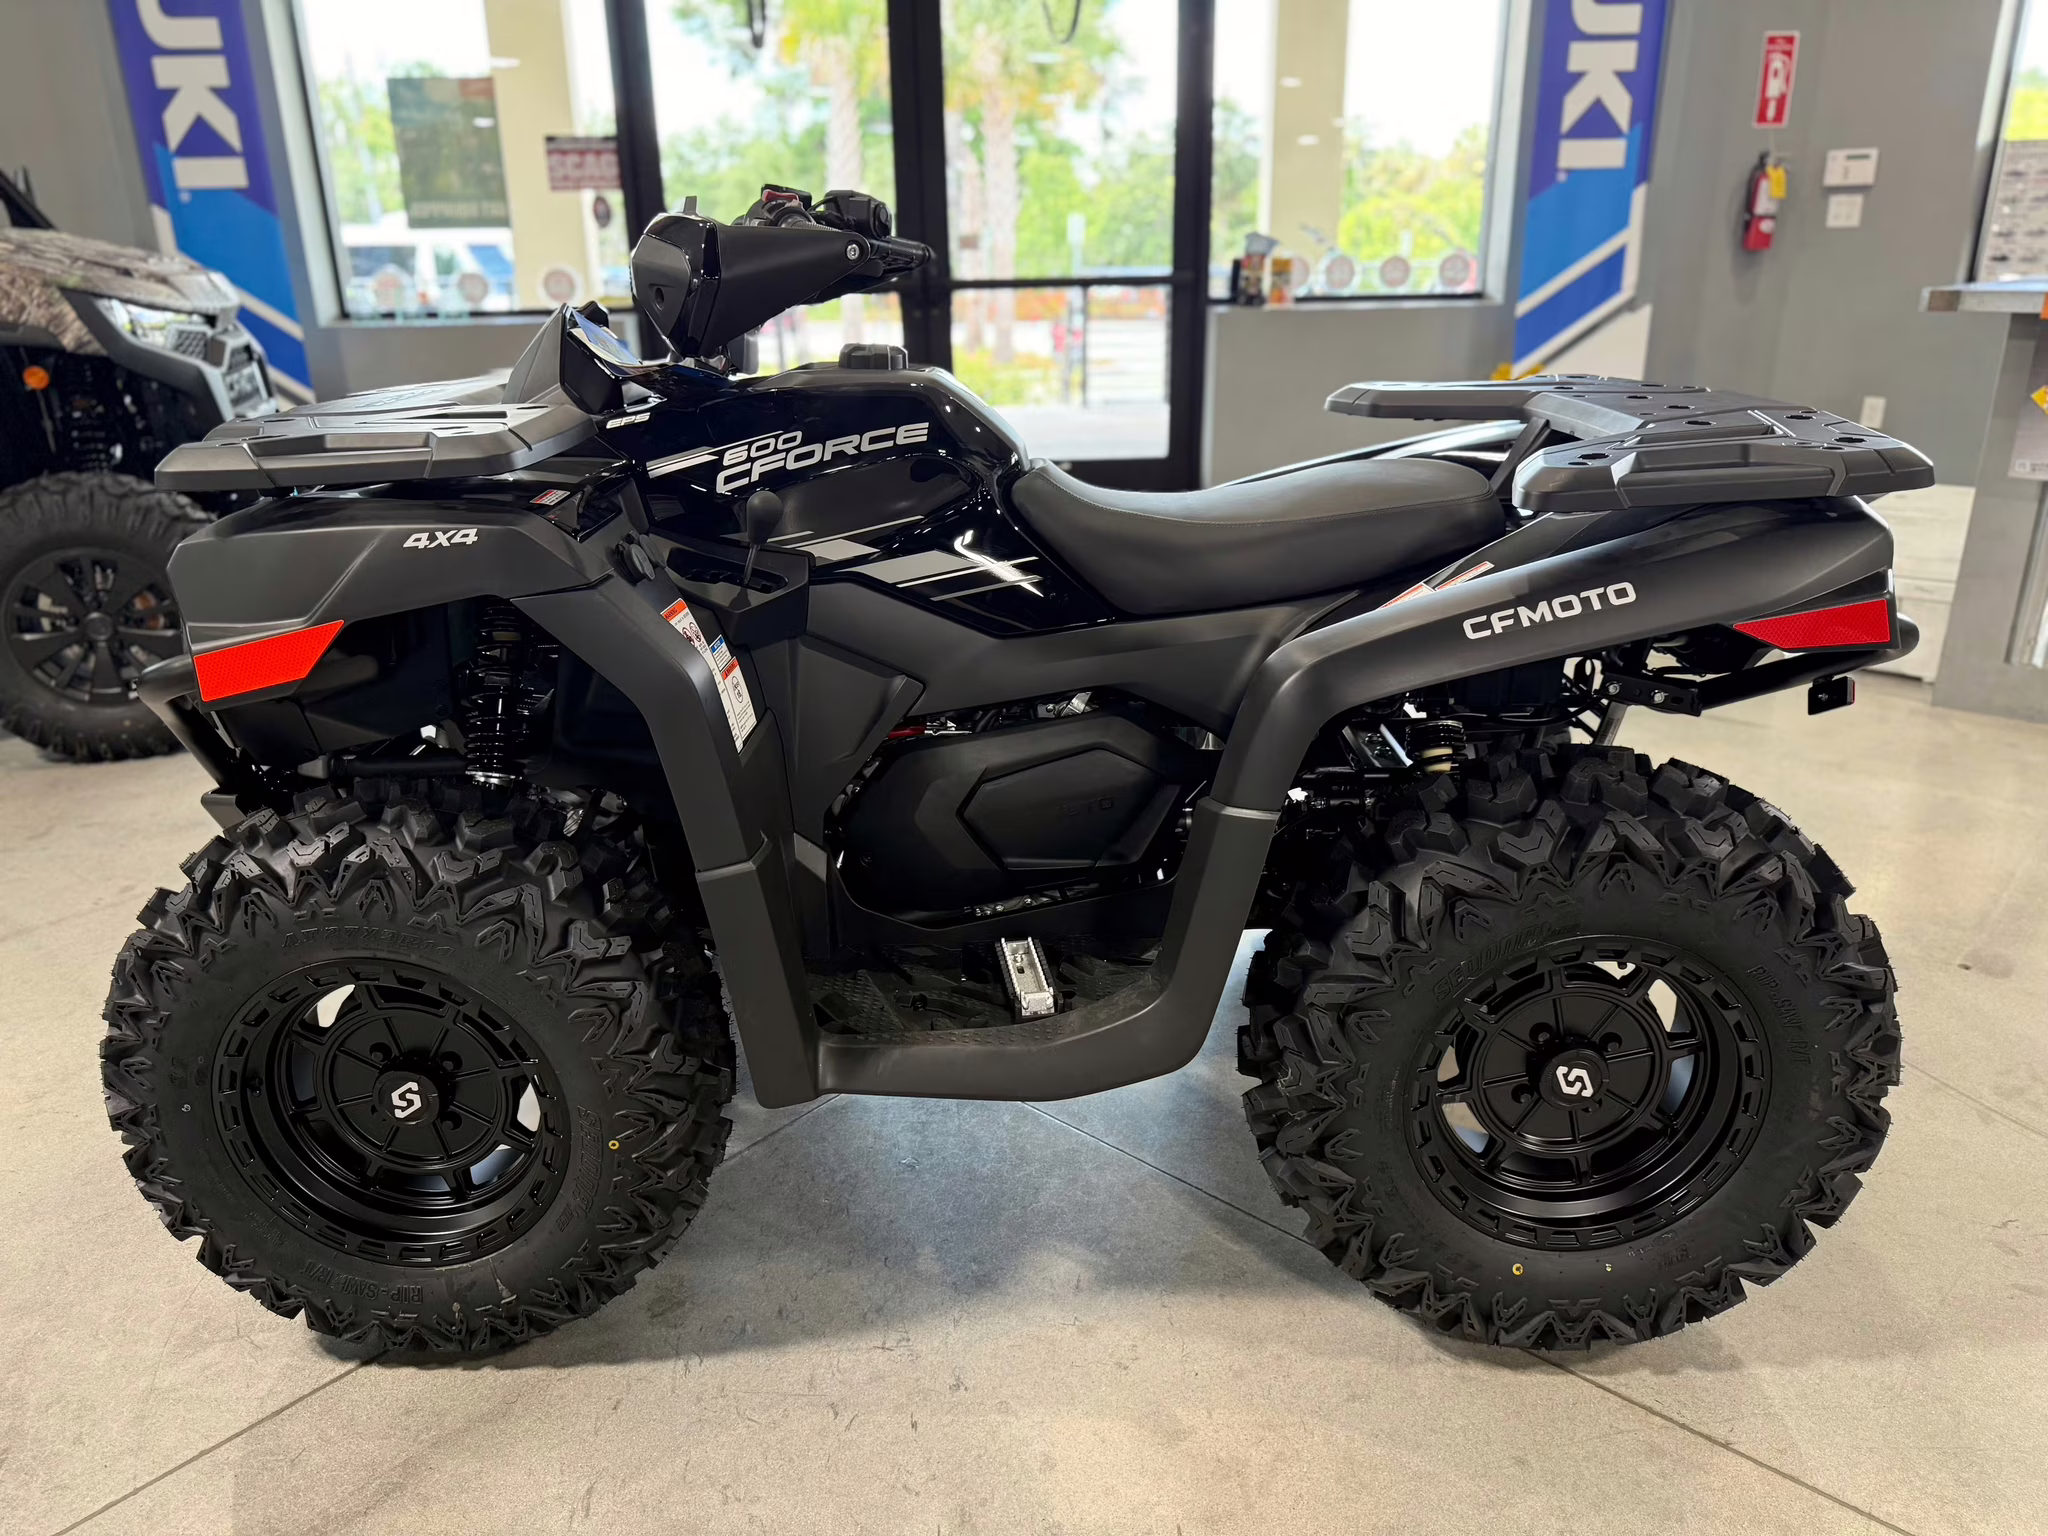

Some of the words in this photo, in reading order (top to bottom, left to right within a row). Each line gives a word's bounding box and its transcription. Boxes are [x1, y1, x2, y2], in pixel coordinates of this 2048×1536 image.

[605, 413, 651, 429] EPS
[715, 421, 930, 495] CFORCE
[723, 430, 802, 467] 600
[1462, 581, 1637, 640] CFMOTO
